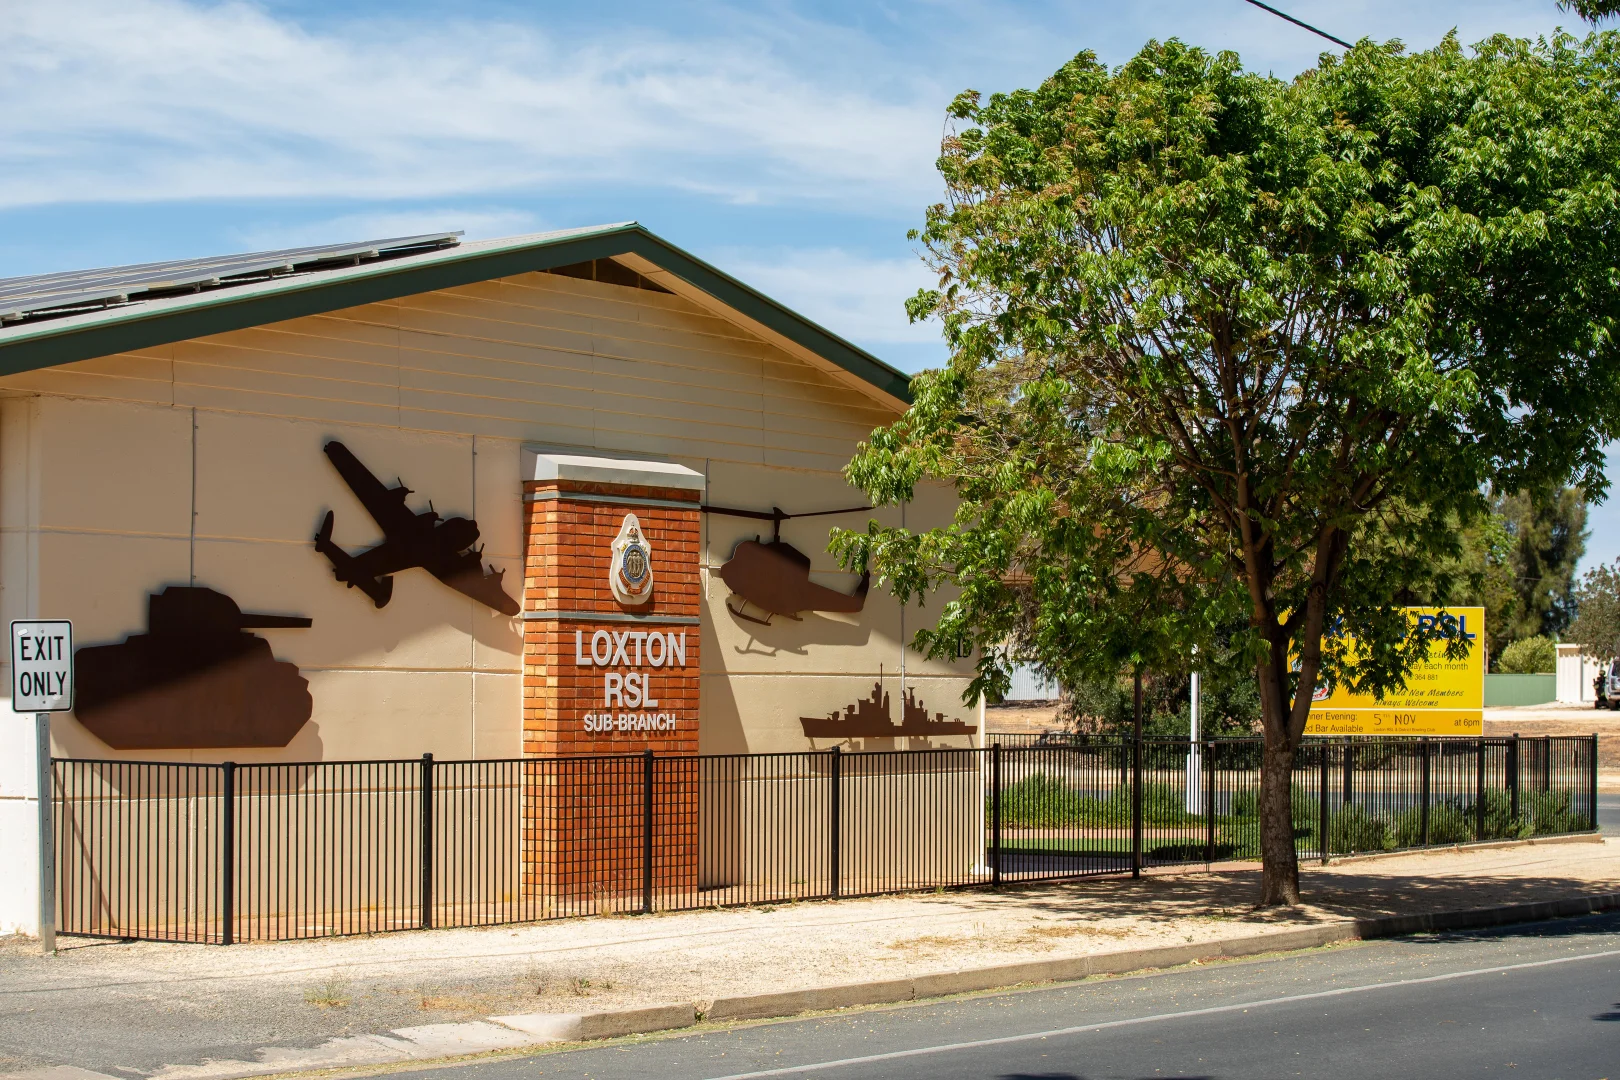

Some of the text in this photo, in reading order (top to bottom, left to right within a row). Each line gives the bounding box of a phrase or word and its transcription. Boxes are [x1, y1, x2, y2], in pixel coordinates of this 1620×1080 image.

[20, 636, 64, 661] EXIT
[575, 629, 686, 667] LOXTON
[1424, 662, 1443, 670] each
[1444, 662, 1469, 671] month
[20, 671, 67, 697] ONLY
[604, 672, 659, 708] RSL
[1409, 689, 1426, 697] New
[1427, 689, 1465, 697] Members
[1373, 699, 1439, 708] Always Welcome
[583, 713, 676, 733] SUB-BRANCH
[1325, 712, 1358, 723] Evening:
[1373, 713, 1382, 726] 5
[1394, 713, 1416, 726] NOV
[1315, 724, 1328, 733] Bar
[1330, 724, 1364, 733] Available
[1454, 719, 1480, 729] at 6pm
